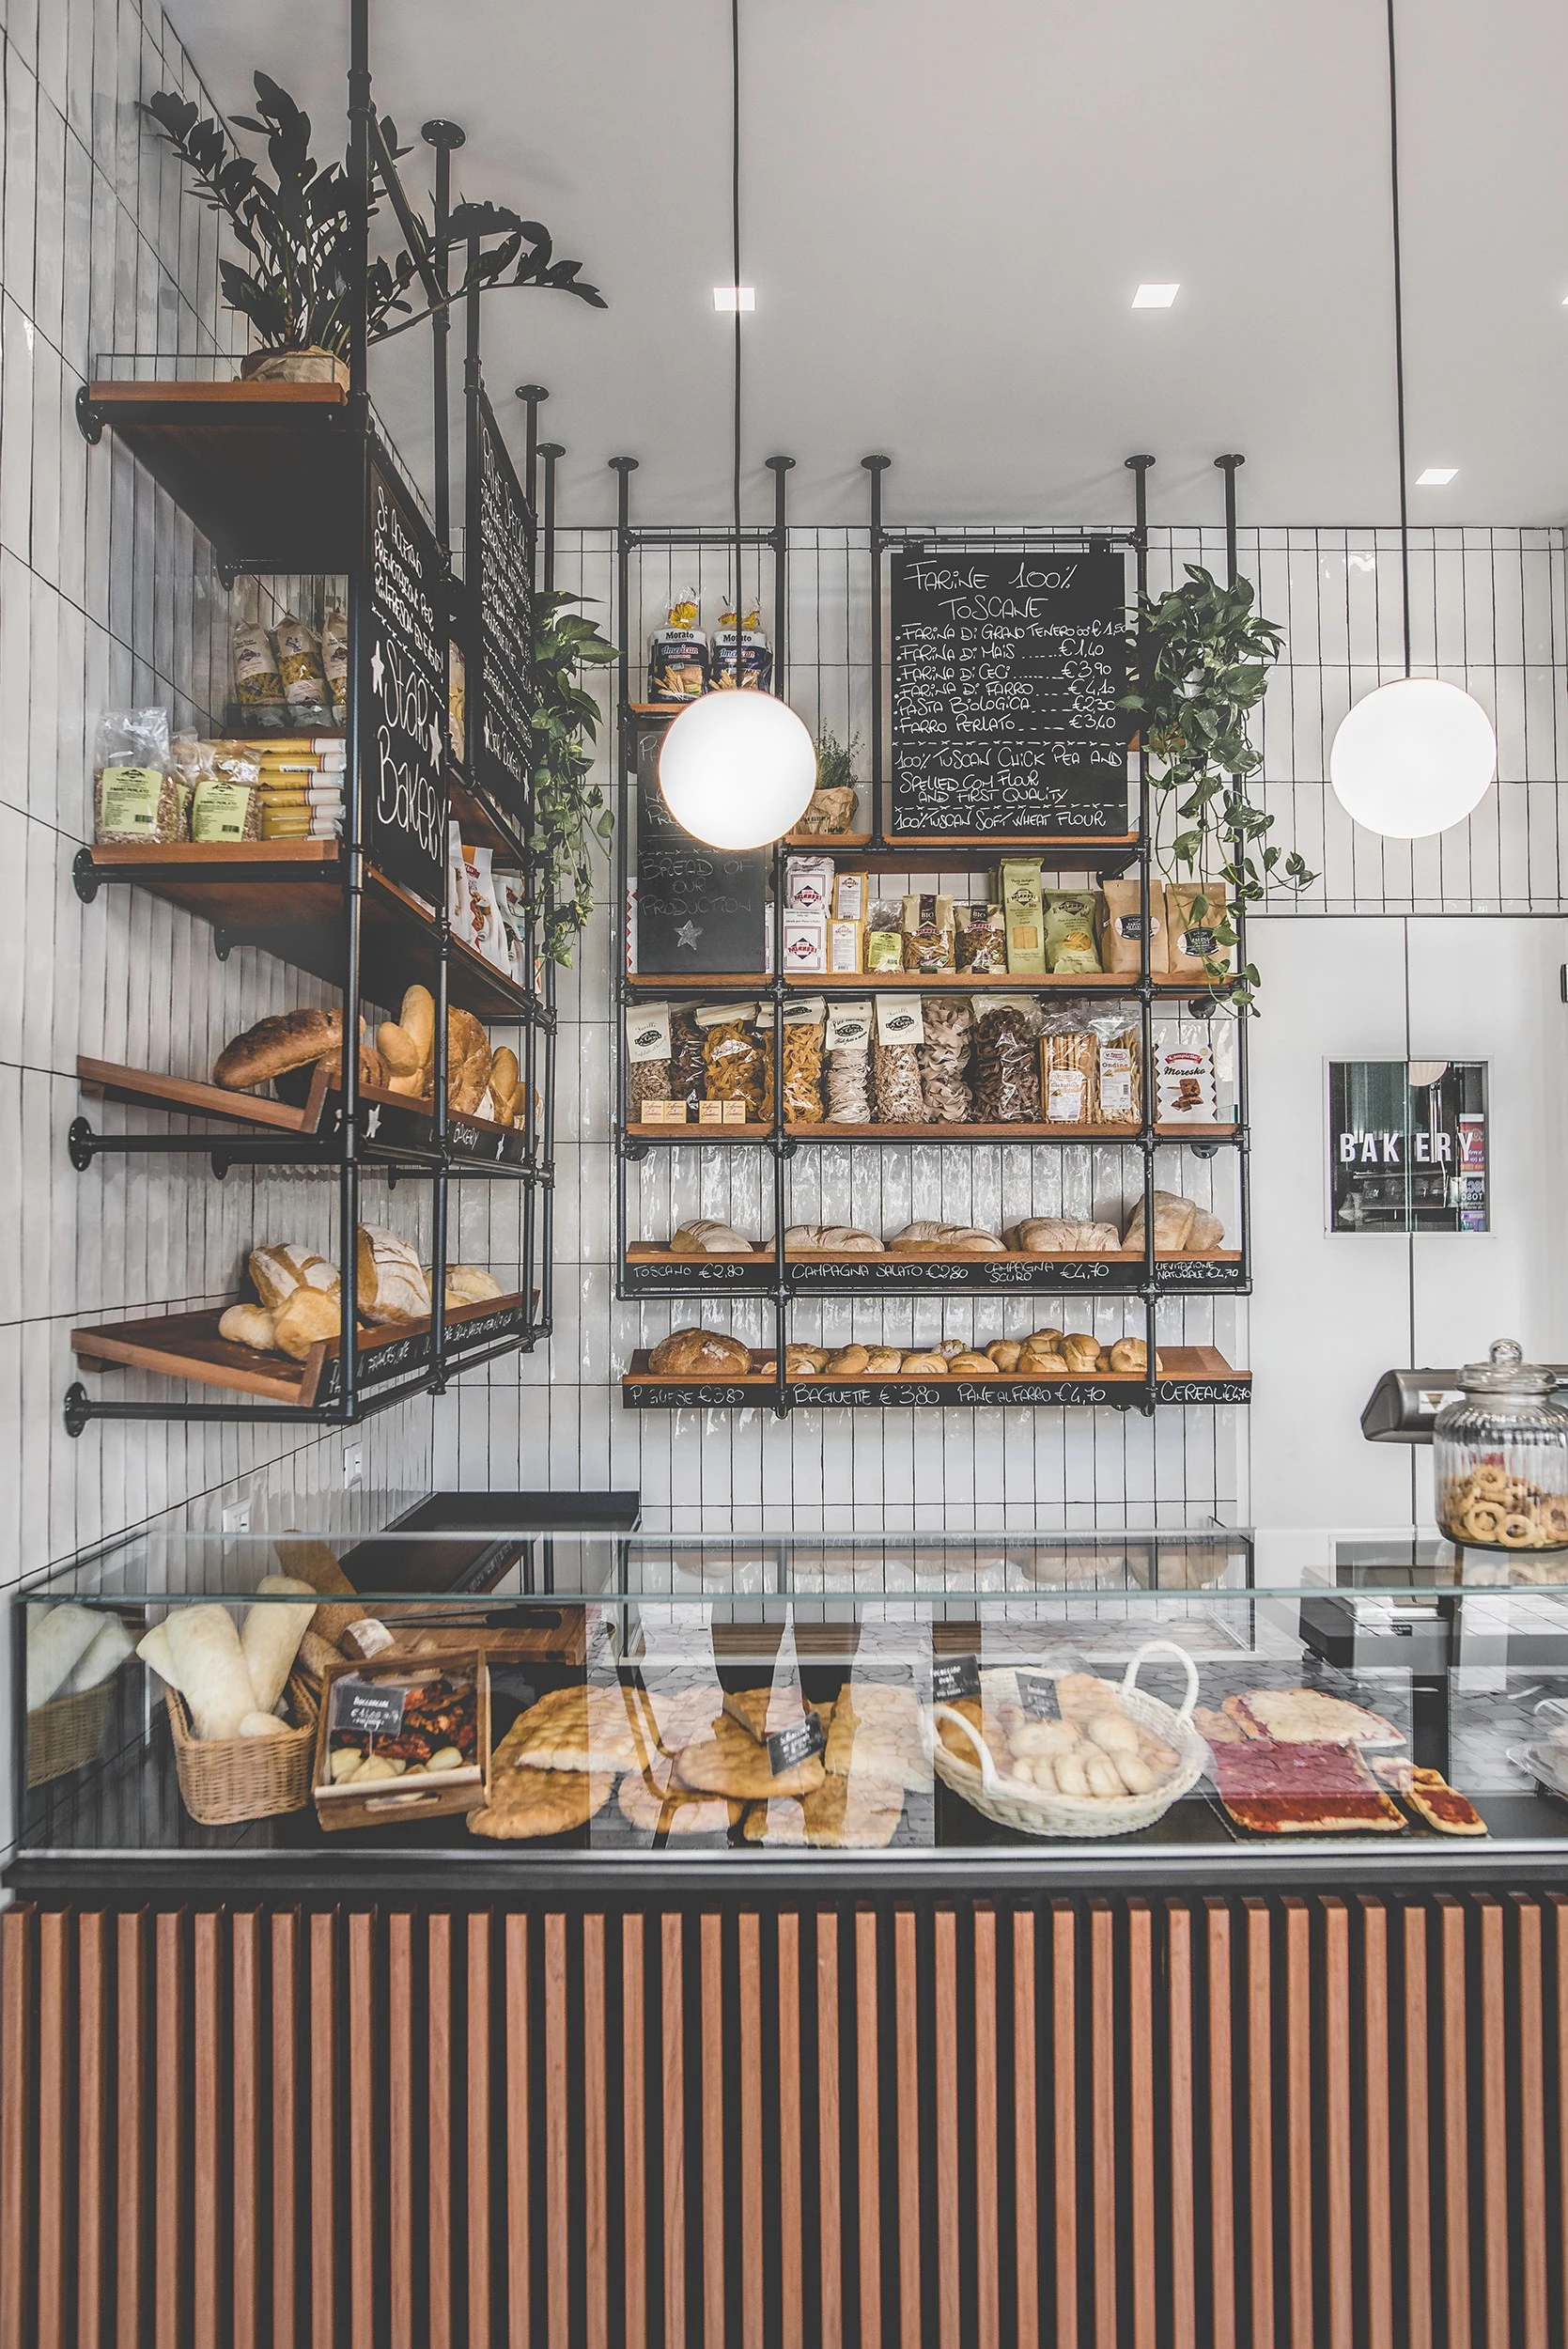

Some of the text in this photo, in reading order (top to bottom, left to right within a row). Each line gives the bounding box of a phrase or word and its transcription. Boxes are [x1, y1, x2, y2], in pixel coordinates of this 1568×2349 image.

[1008, 562, 1078, 589] 100%
[939, 595, 1048, 620] TOSCANE
[665, 630, 694, 640] Morato
[982, 624, 1025, 640] GRANO
[1027, 623, 1075, 637] TENERO
[986, 680, 1033, 696] FARRO
[897, 696, 943, 716] PASTA
[899, 716, 947, 734] FARRO
[894, 751, 931, 770] 100%
[1051, 743, 1080, 767] PEA
[1090, 751, 1123, 767] AND
[997, 770, 1040, 787] FLOUR
[918, 790, 950, 803] AND
[955, 788, 1000, 803] FIRST
[894, 811, 929, 831] 100%
[1012, 809, 1051, 827] WHEAT
[1055, 810, 1107, 827] FLOUR
[642, 858, 754, 880] BREAD OF
[673, 877, 706, 894] OUR
[639, 894, 753, 917] PRODUCTION
[1164, 1066, 1205, 1076] Moresko
[1340, 1132, 1473, 1163] BAKERY
[633, 1266, 691, 1279] TOSCANO
[791, 1264, 869, 1280] CAMPAGNA
[876, 1264, 923, 1277] SALATO
[985, 1261, 1054, 1273] CAMPAGNA
[1157, 1269, 1204, 1280] NATURALE
[989, 1271, 1032, 1283] SCURO
[793, 1383, 872, 1405] BAGUETTE
[957, 1382, 993, 1403] PANE
[1011, 1385, 1051, 1402] FARRO
